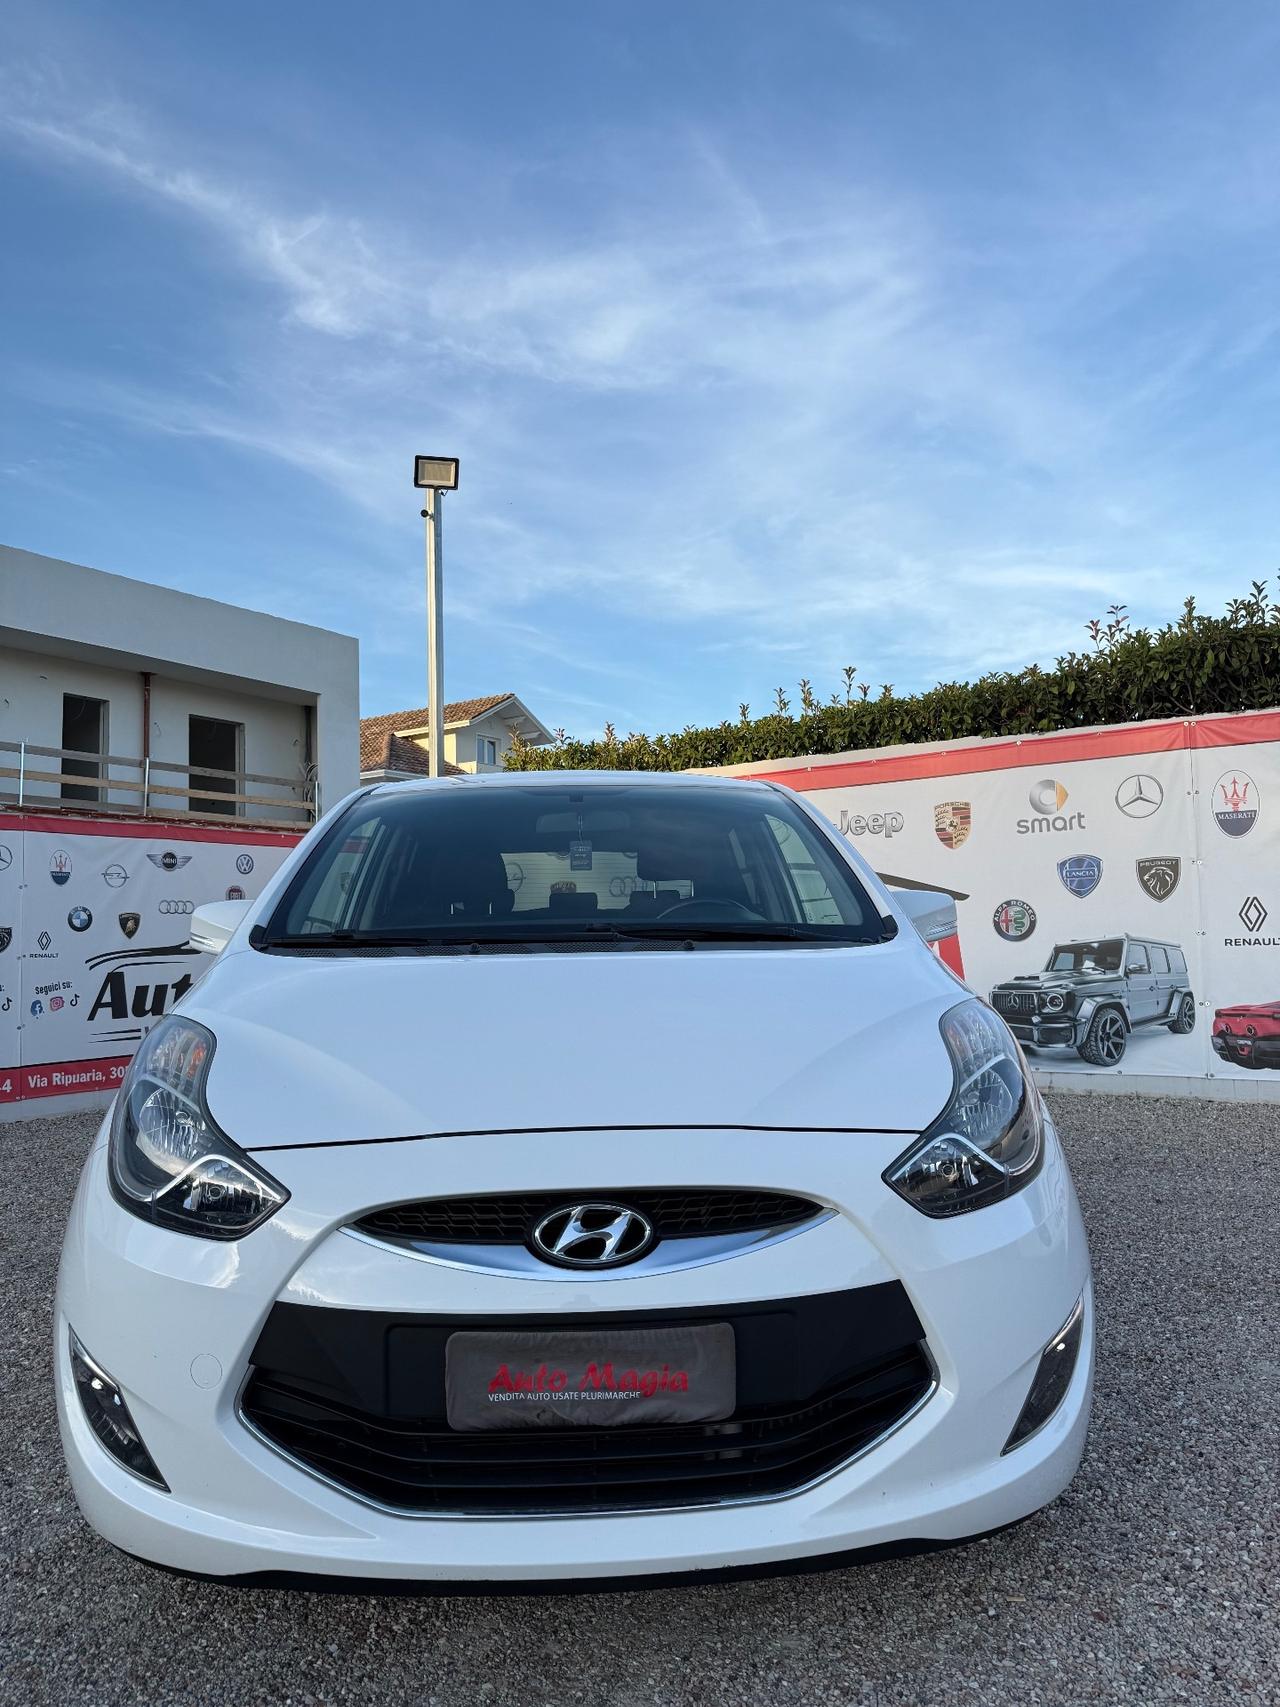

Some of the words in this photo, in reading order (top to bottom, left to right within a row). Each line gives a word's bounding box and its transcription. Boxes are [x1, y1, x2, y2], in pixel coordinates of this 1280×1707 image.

[1218, 811, 1256, 820] MASERATI
[833, 810, 904, 838] Jeep
[1017, 812, 1086, 834] smart
[1066, 869, 1095, 878] LANCIA
[1224, 937, 1280, 946] RENAUL
[62, 981, 73, 989] su:
[28, 1074, 48, 1089] Via
[52, 1069, 106, 1086] Ripuaria,
[110, 1065, 129, 1079] 30
[488, 1363, 568, 1392] Auto
[579, 1362, 689, 1397] Magia
[488, 1393, 525, 1401] VENDITA
[552, 1392, 579, 1400] USATE
[581, 1391, 641, 1400] PLURIMARCHE
